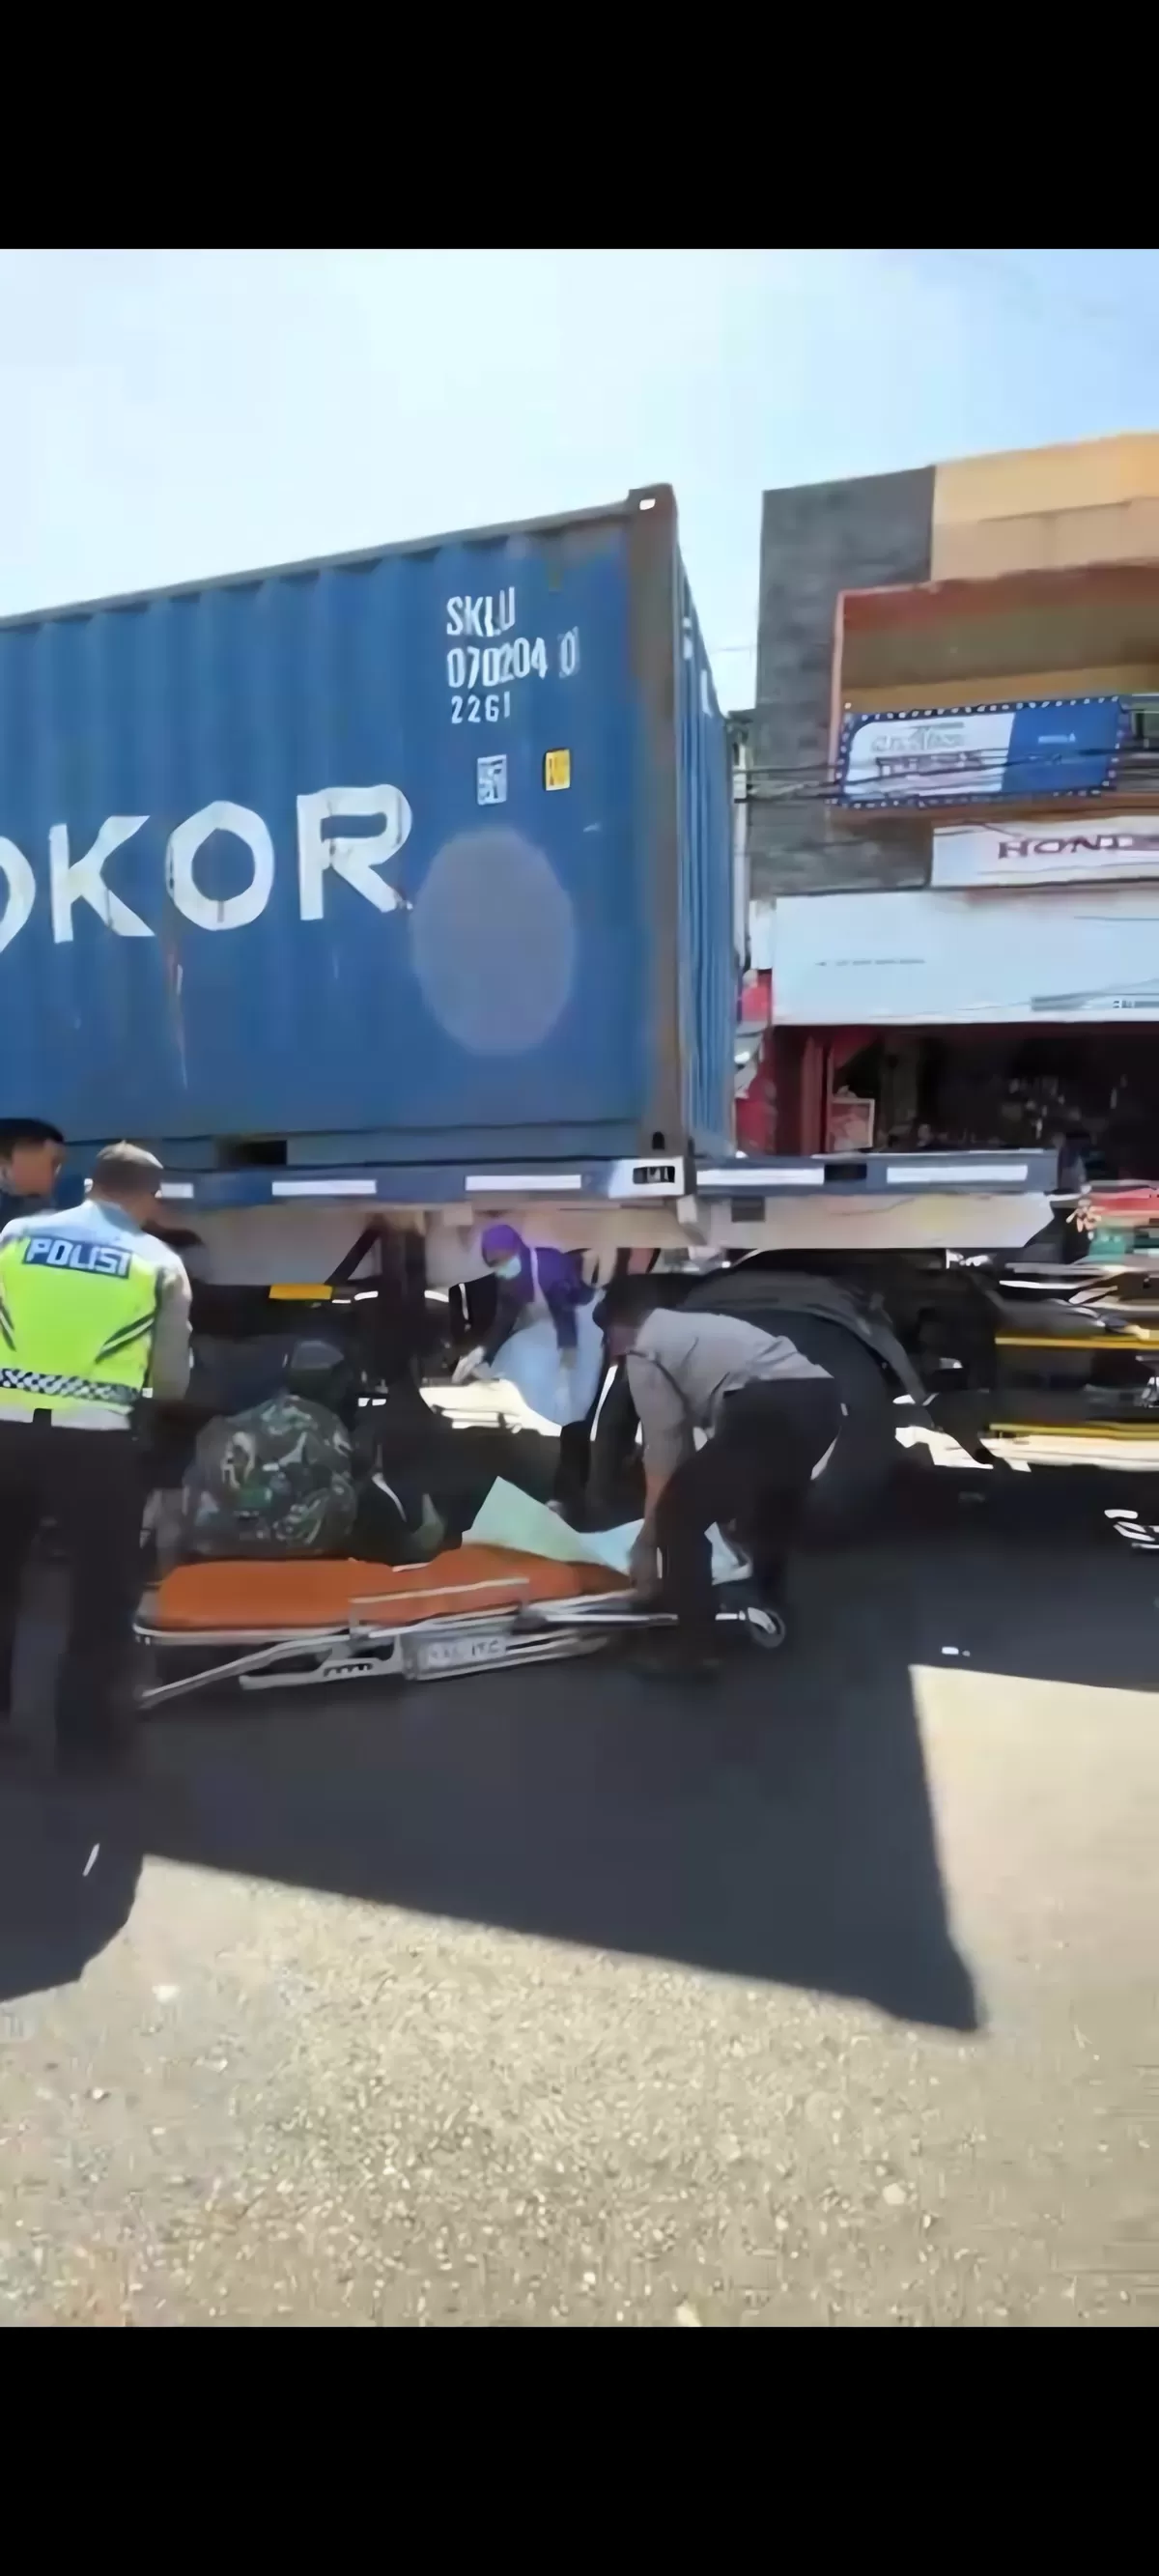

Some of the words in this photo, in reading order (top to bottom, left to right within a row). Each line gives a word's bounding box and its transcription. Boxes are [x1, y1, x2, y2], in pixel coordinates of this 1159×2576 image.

[446, 586, 516, 637] SKLU
[446, 637, 548, 689] 070204
[998, 834, 1159, 859] HOND
[25, 1237, 130, 1277] POLISI
